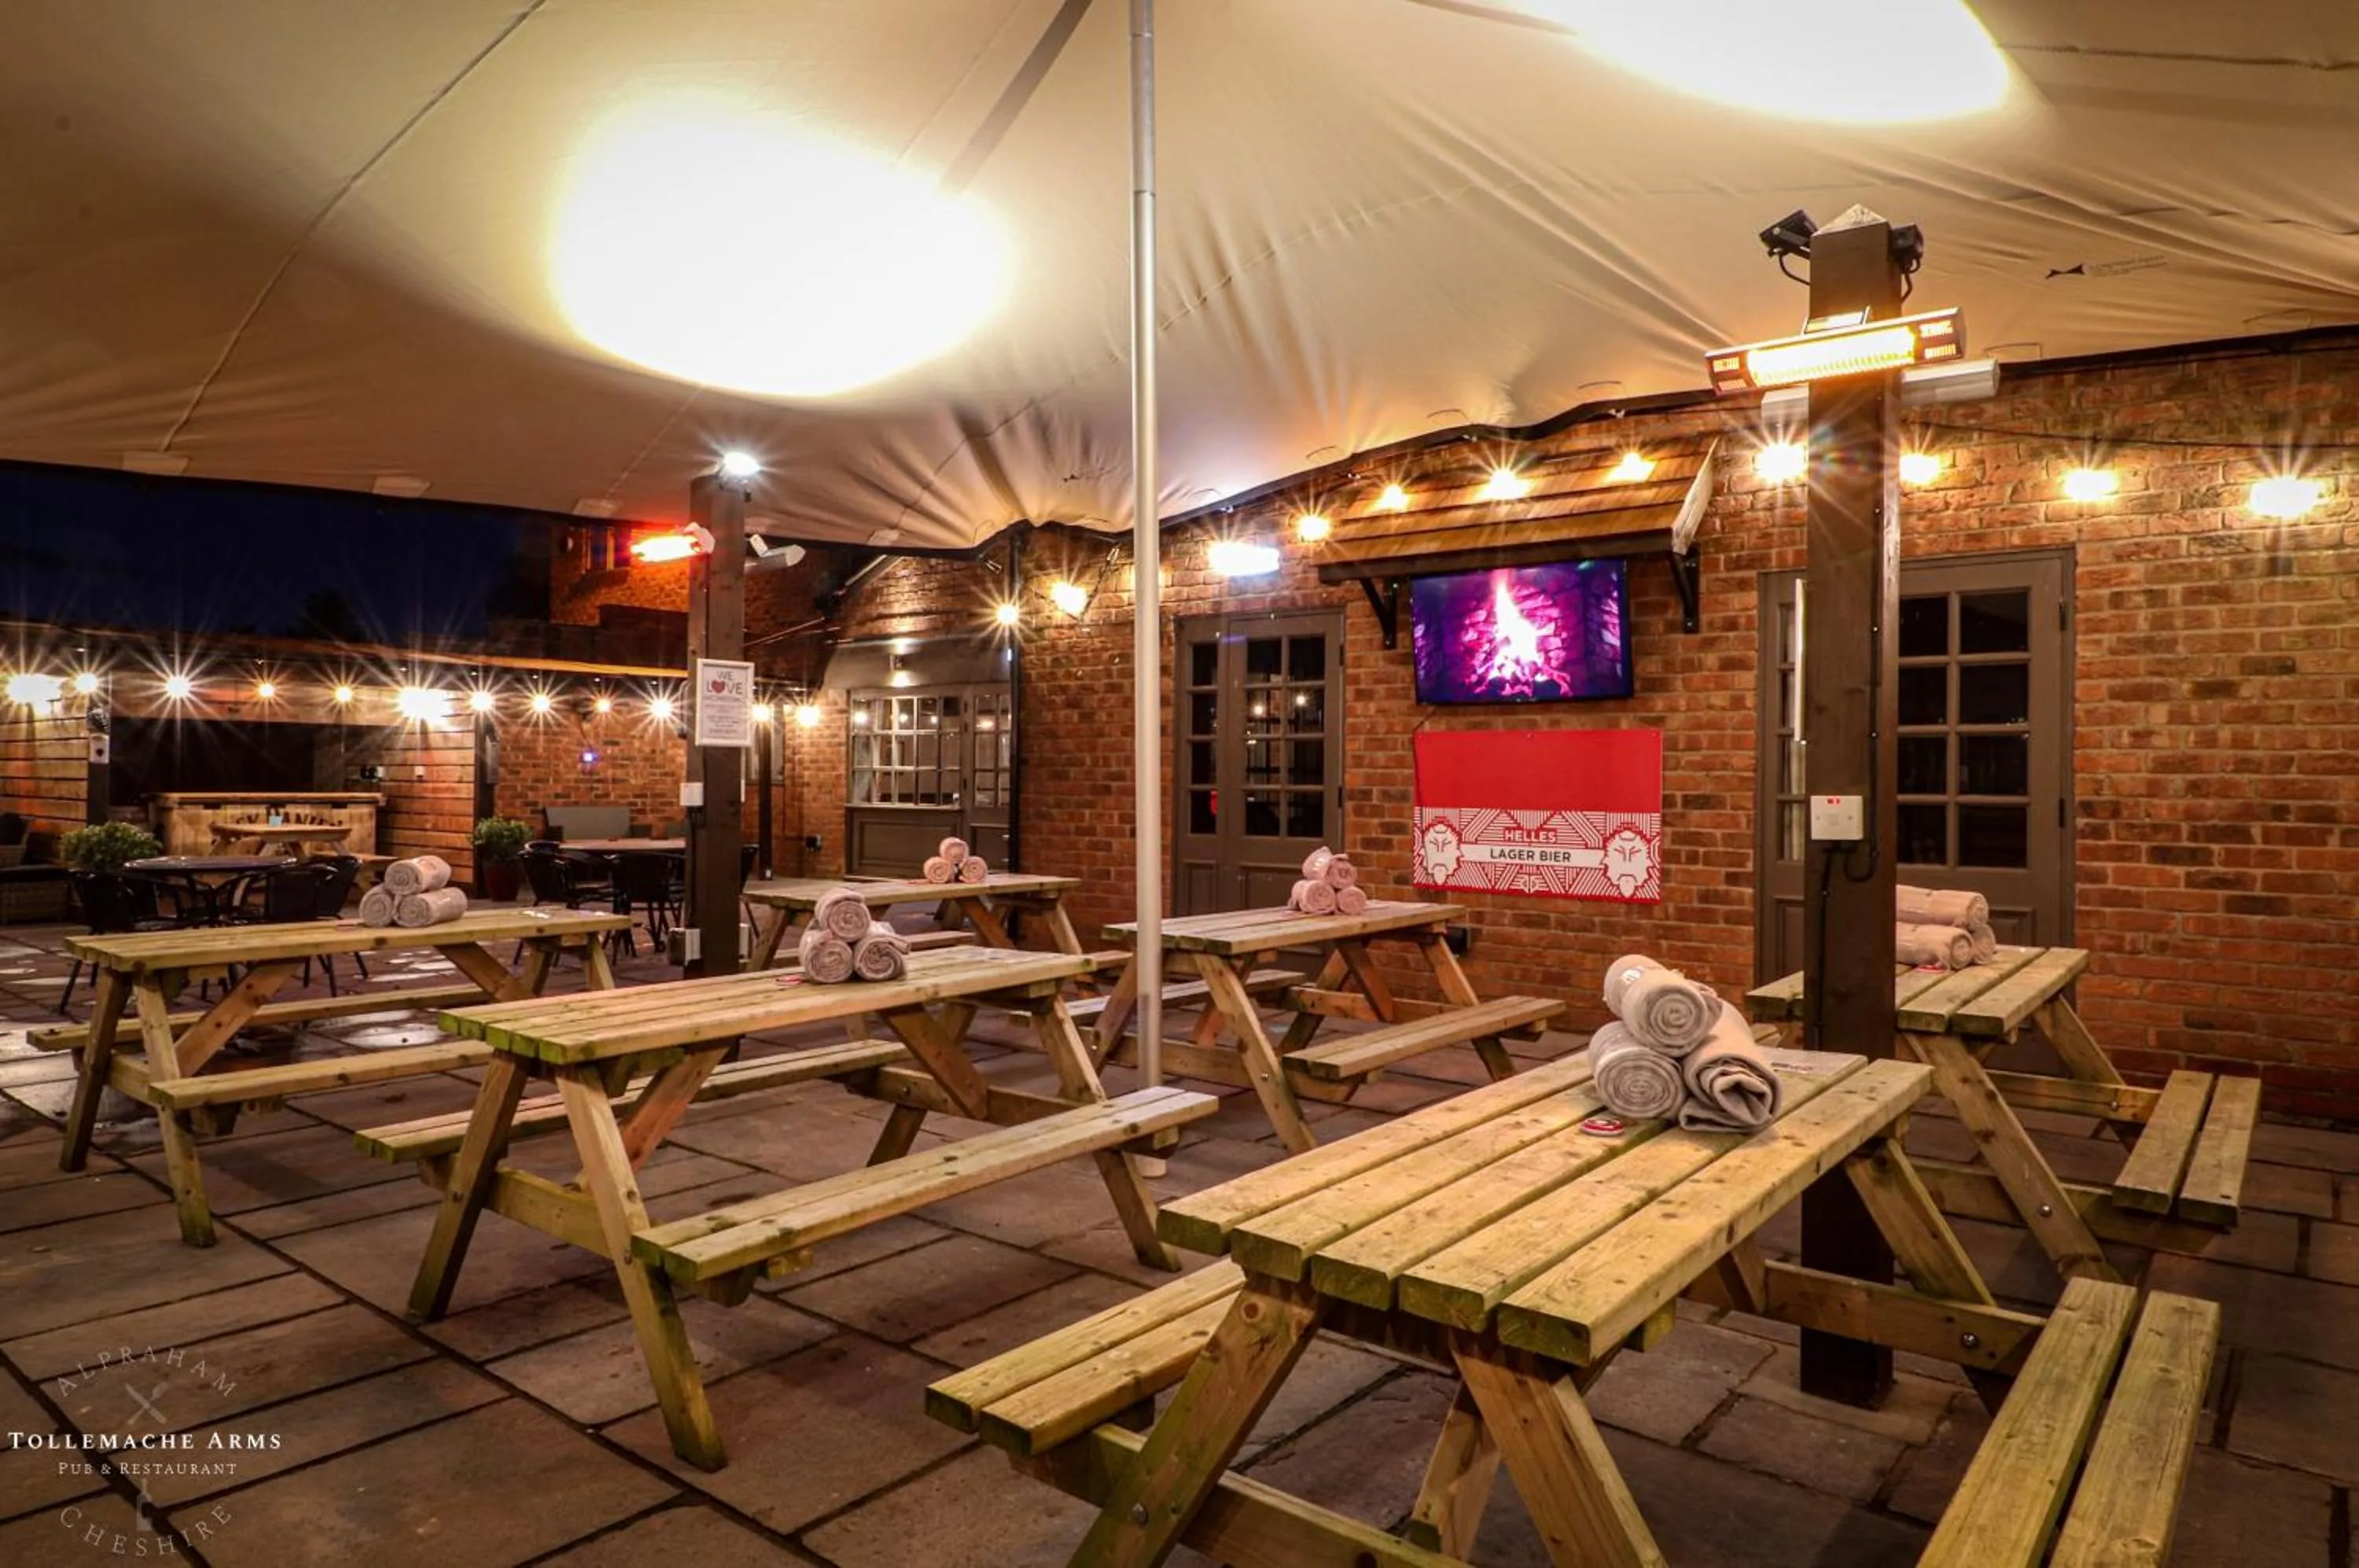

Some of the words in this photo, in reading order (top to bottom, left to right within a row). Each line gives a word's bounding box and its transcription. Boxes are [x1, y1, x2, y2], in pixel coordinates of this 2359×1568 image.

[717, 670, 734, 681] WE
[1504, 830, 1556, 843] HELLES
[1490, 848, 1535, 861] LAGER
[1539, 850, 1571, 863] BIER
